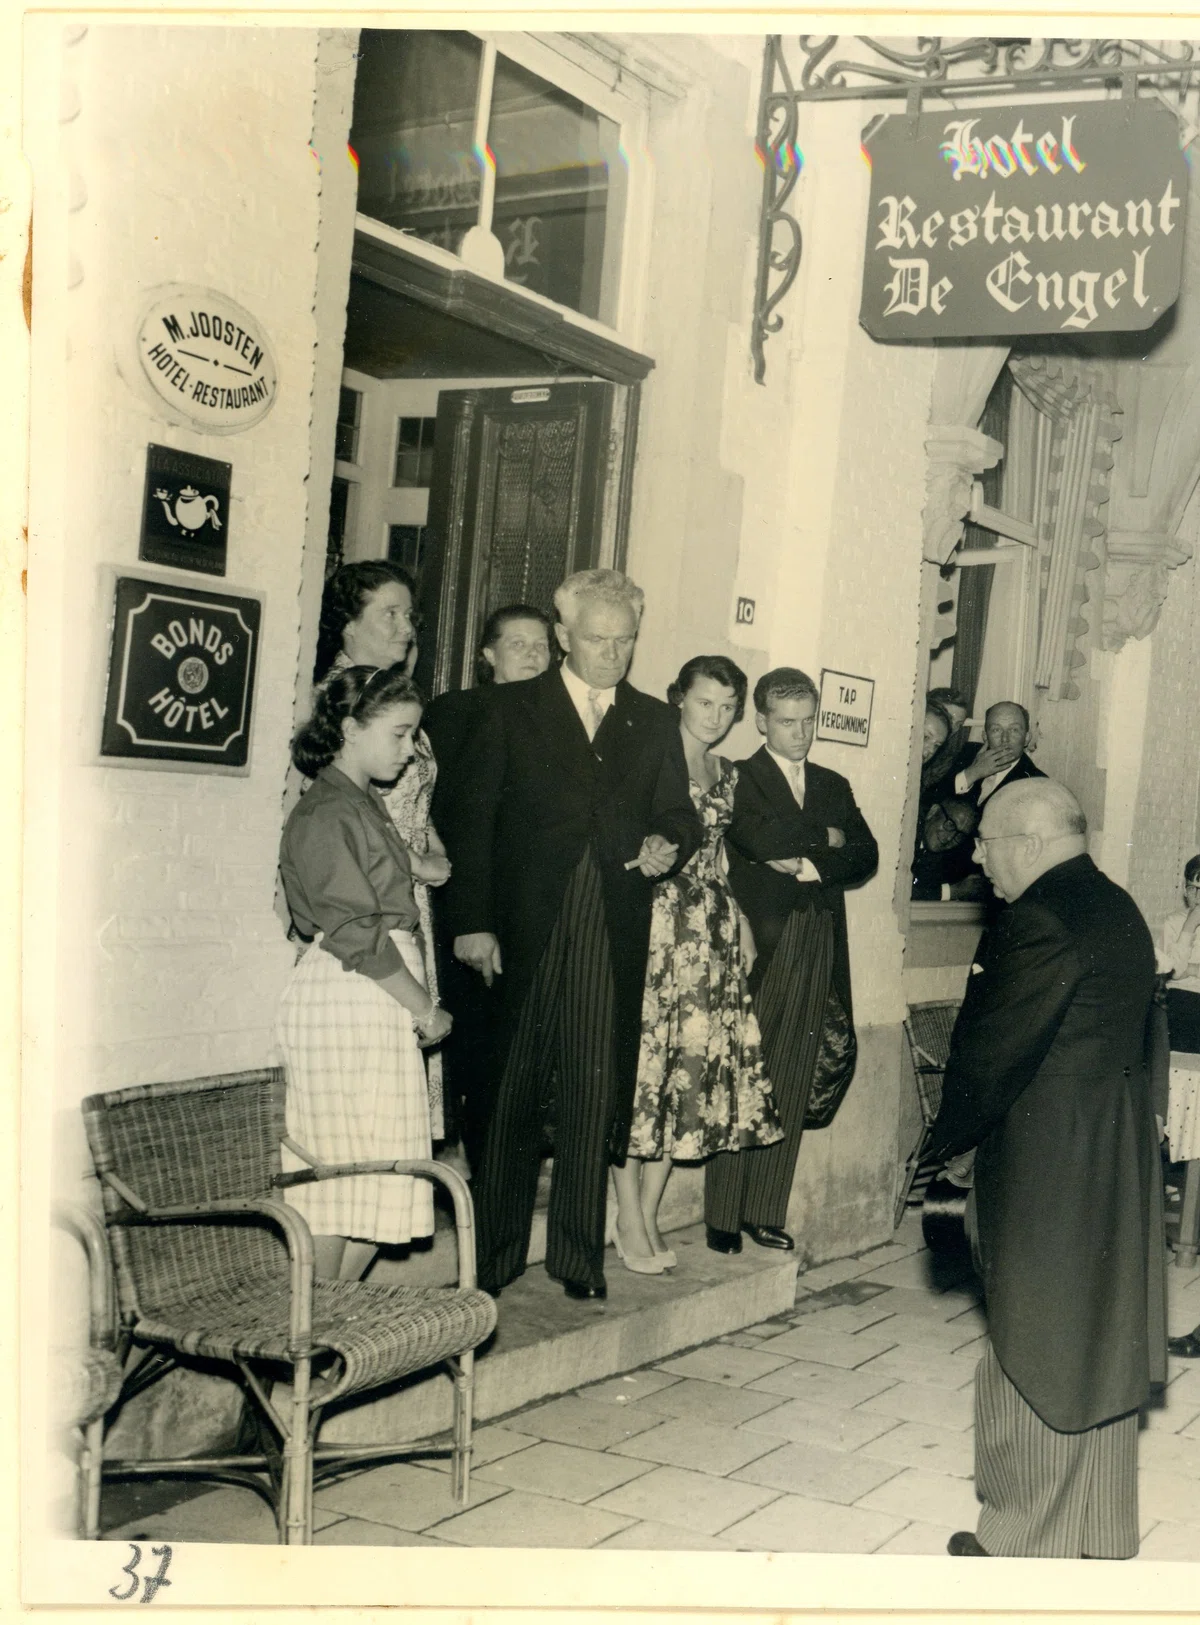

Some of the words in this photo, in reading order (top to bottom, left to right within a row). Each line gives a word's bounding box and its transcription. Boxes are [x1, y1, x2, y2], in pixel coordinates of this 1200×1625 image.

[938, 114, 1088, 181] Hotel
[875, 179, 1181, 252] Restaurant
[883, 256, 954, 317] De
[986, 245, 1152, 330] Engel
[738, 600, 754, 623] 10
[150, 617, 234, 666] BONDS
[821, 710, 868, 735] VERGUNNING
[839, 686, 857, 706] TAP
[108, 1543, 173, 1604] 37
